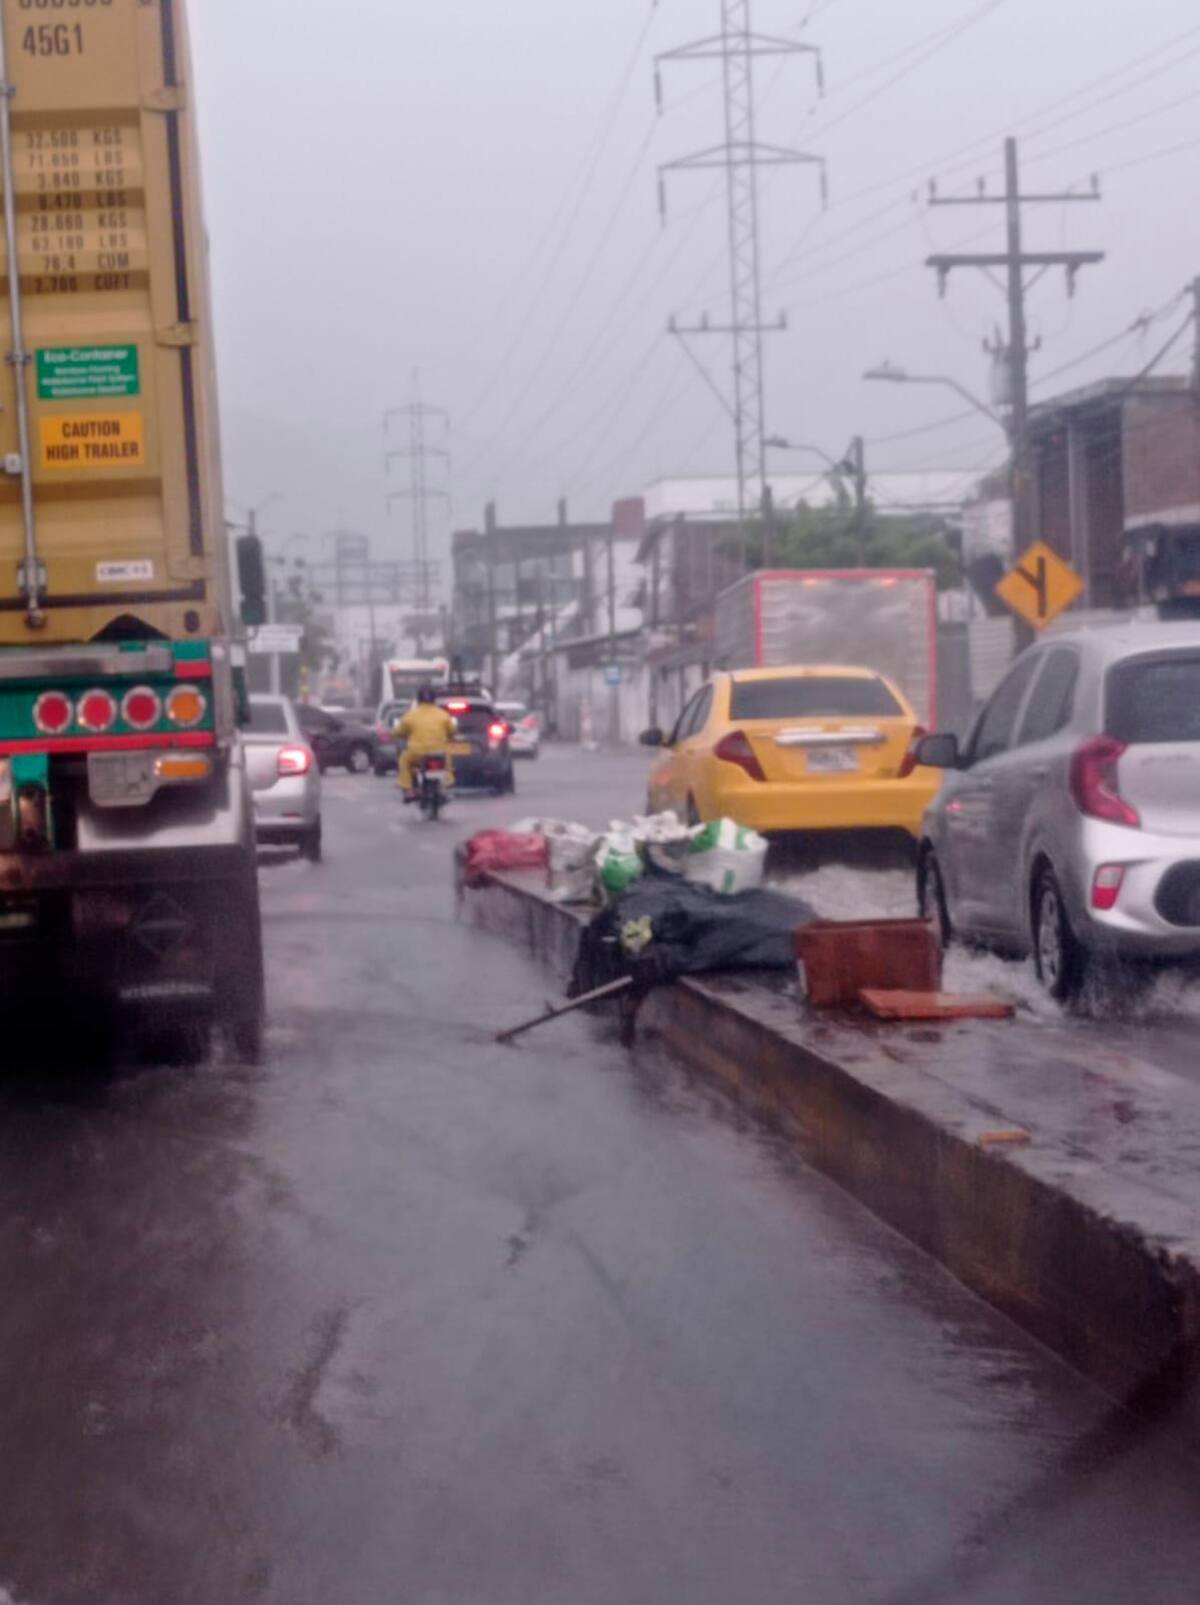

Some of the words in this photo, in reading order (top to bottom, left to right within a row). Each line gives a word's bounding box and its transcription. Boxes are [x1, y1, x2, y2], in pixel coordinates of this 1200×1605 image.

[23, 23, 83, 56] 45G1
[93, 128, 122, 145] KGS
[94, 151, 123, 166] LBS
[96, 170, 123, 186] KGS
[97, 190, 127, 208] LBS
[98, 212, 127, 229] KGS
[98, 232, 127, 248] LBS
[98, 252, 129, 269] CUM
[62, 420, 120, 438] CAUTION
[46, 444, 79, 461] HIGH
[84, 441, 139, 460] TRAILER
